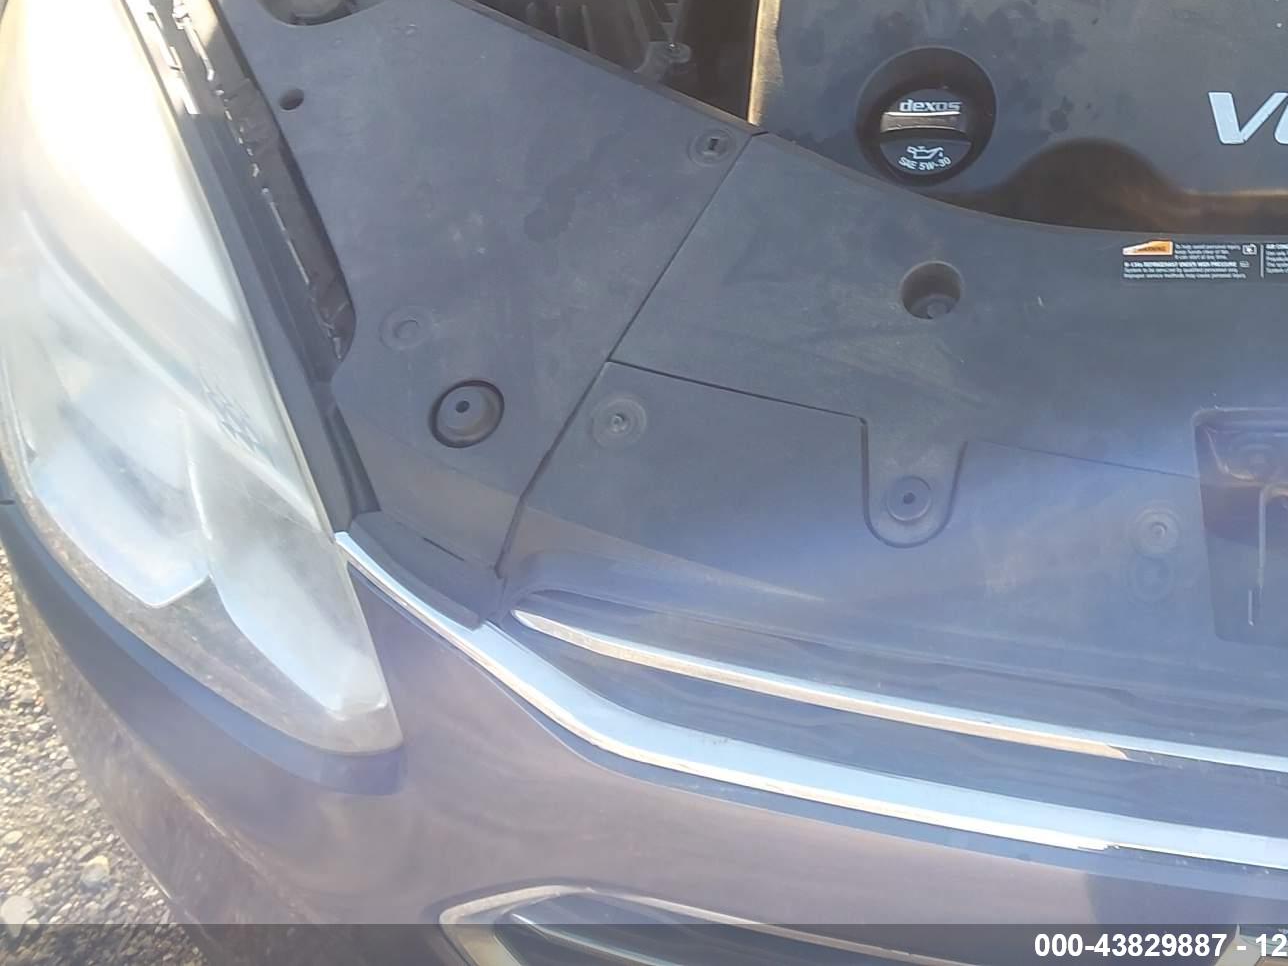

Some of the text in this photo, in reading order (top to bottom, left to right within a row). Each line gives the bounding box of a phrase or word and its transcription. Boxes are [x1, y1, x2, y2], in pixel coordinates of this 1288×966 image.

[899, 99, 962, 112] dexos
[899, 156, 952, 171] SAE 5W-30
